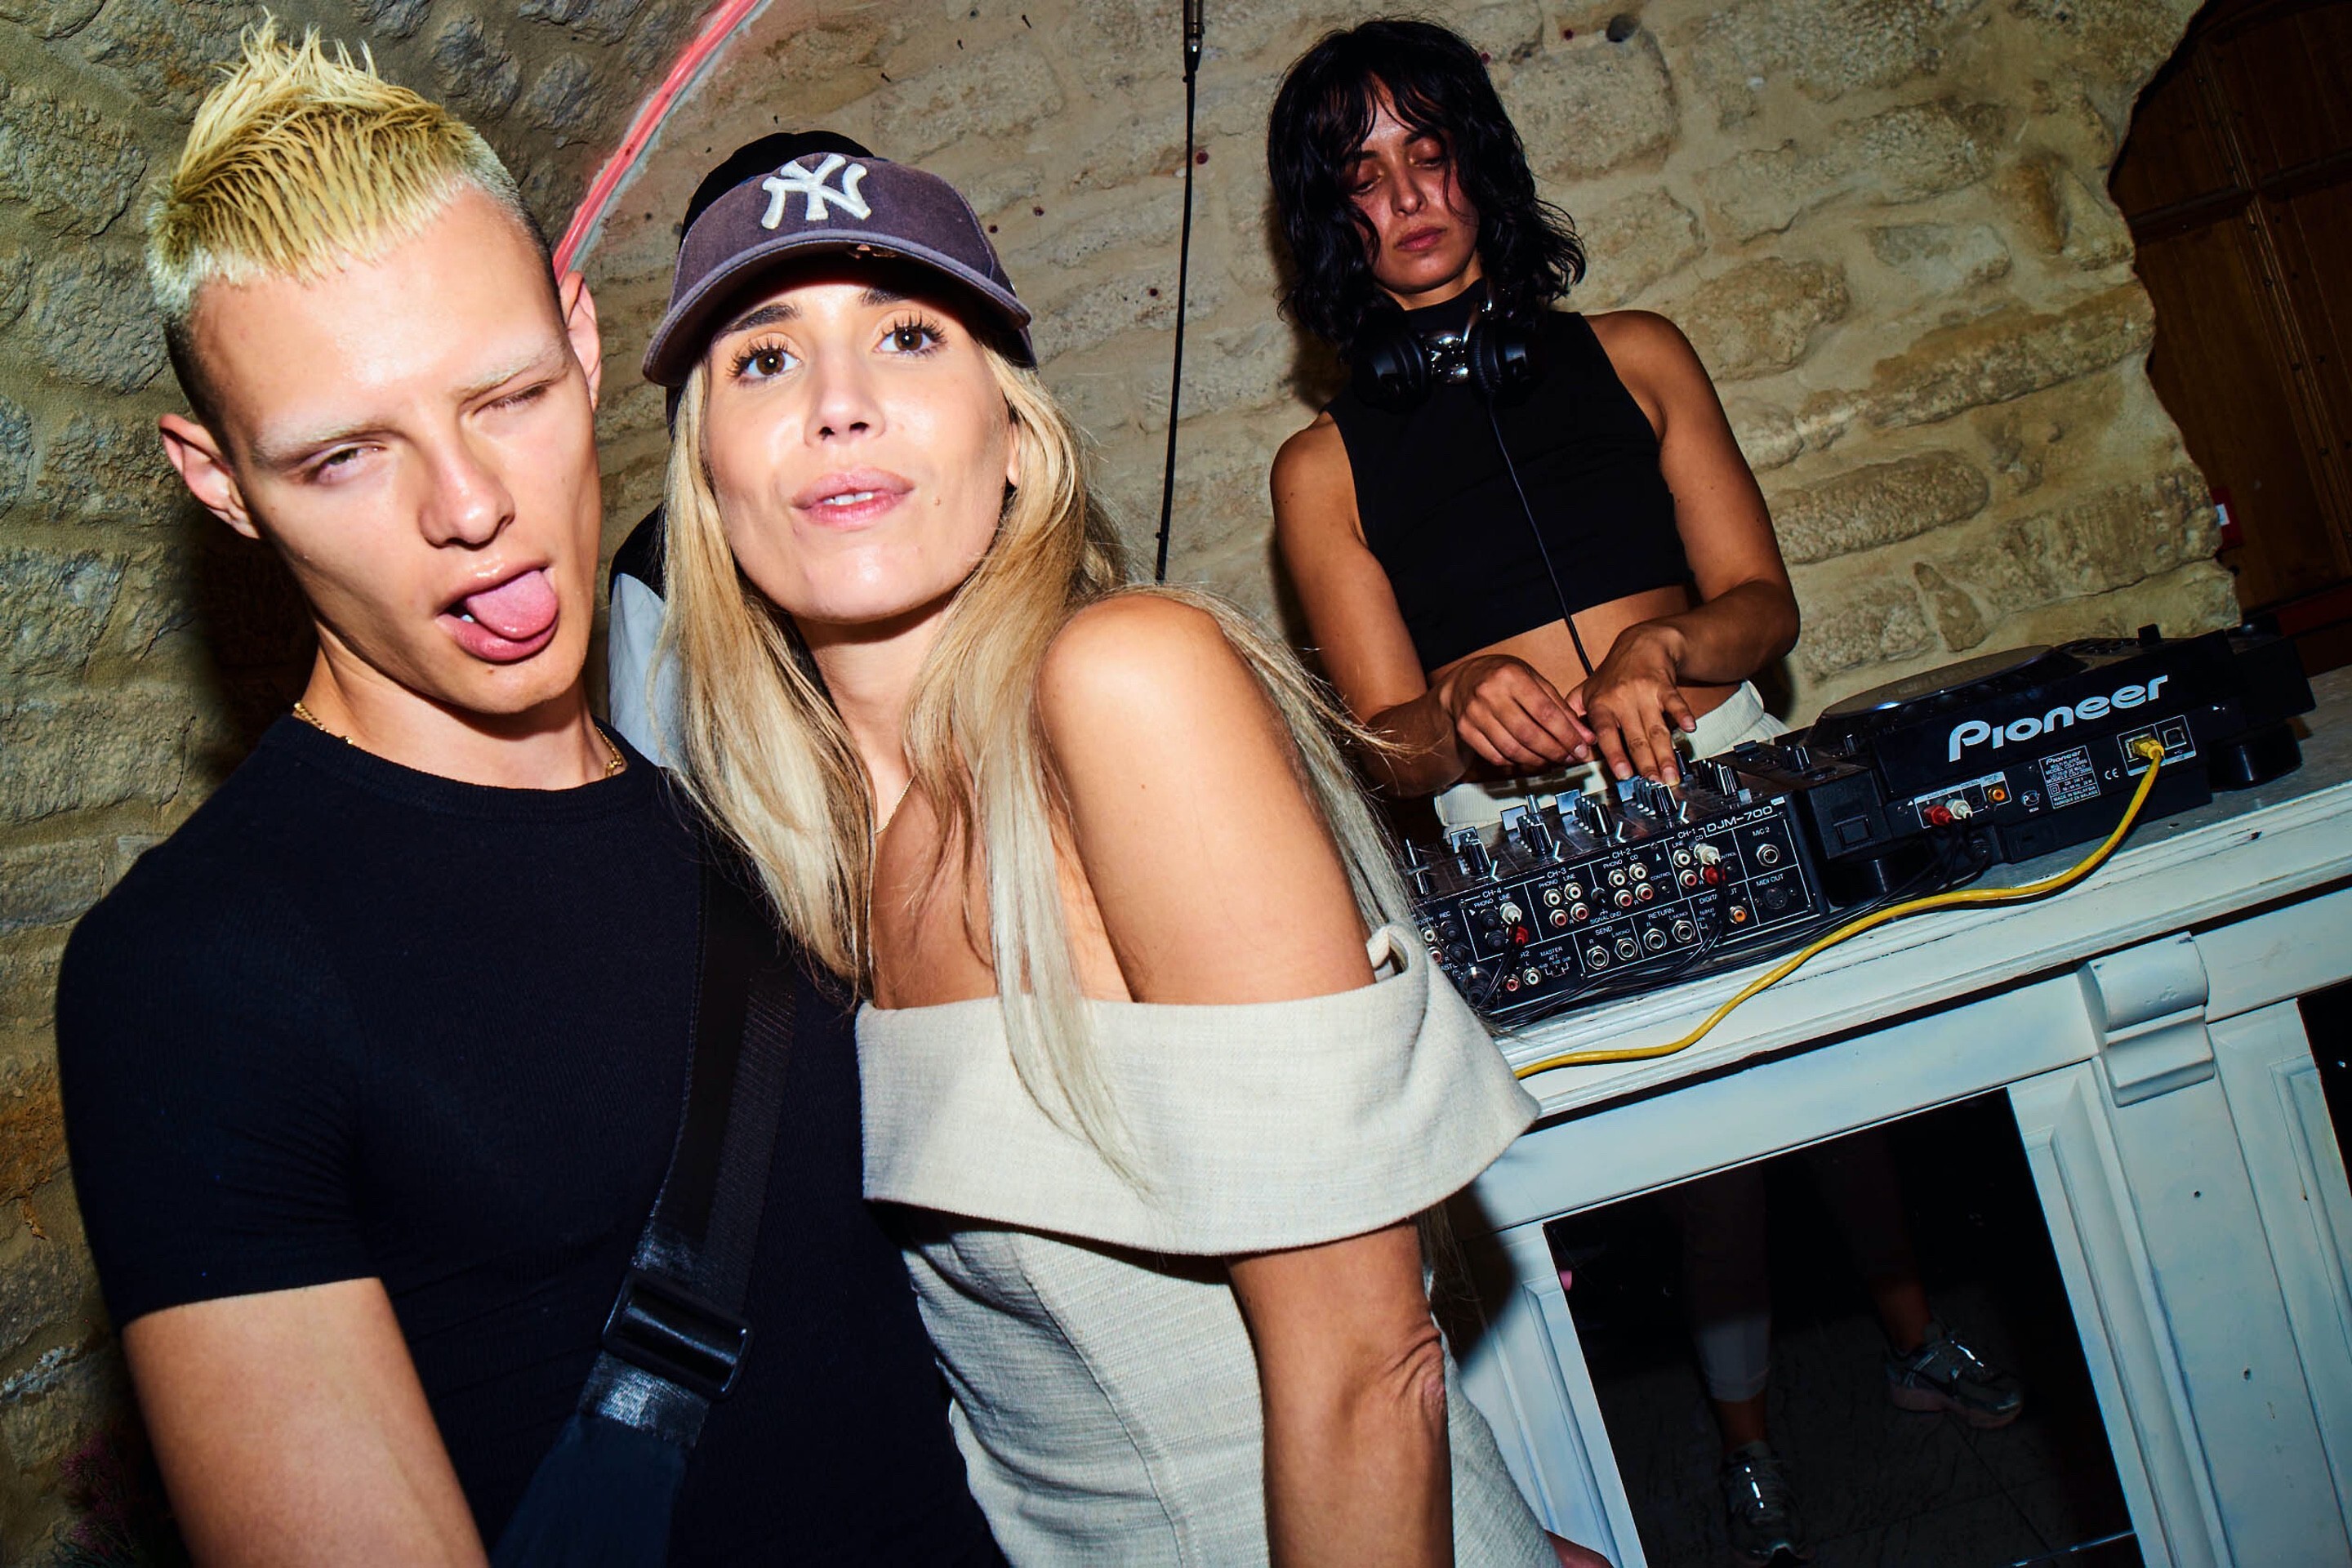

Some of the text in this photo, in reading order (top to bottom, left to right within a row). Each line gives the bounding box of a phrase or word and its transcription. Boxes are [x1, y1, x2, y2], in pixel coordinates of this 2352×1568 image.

[760, 153, 871, 229] NY
[1949, 675, 2168, 762] Pioneer
[2046, 750, 2082, 765] Pioneer
[1706, 806, 1773, 832] DJM-700
[1677, 828, 1696, 839] CH-1
[1612, 848, 1632, 859] CH-2
[1547, 867, 1567, 879] CH-3
[1771, 873, 1784, 882] OUT
[1482, 887, 1502, 898] CH-4
[1648, 907, 1675, 920] RETURN
[1595, 925, 1613, 936] SEND
[1539, 947, 1563, 956] MASTER
